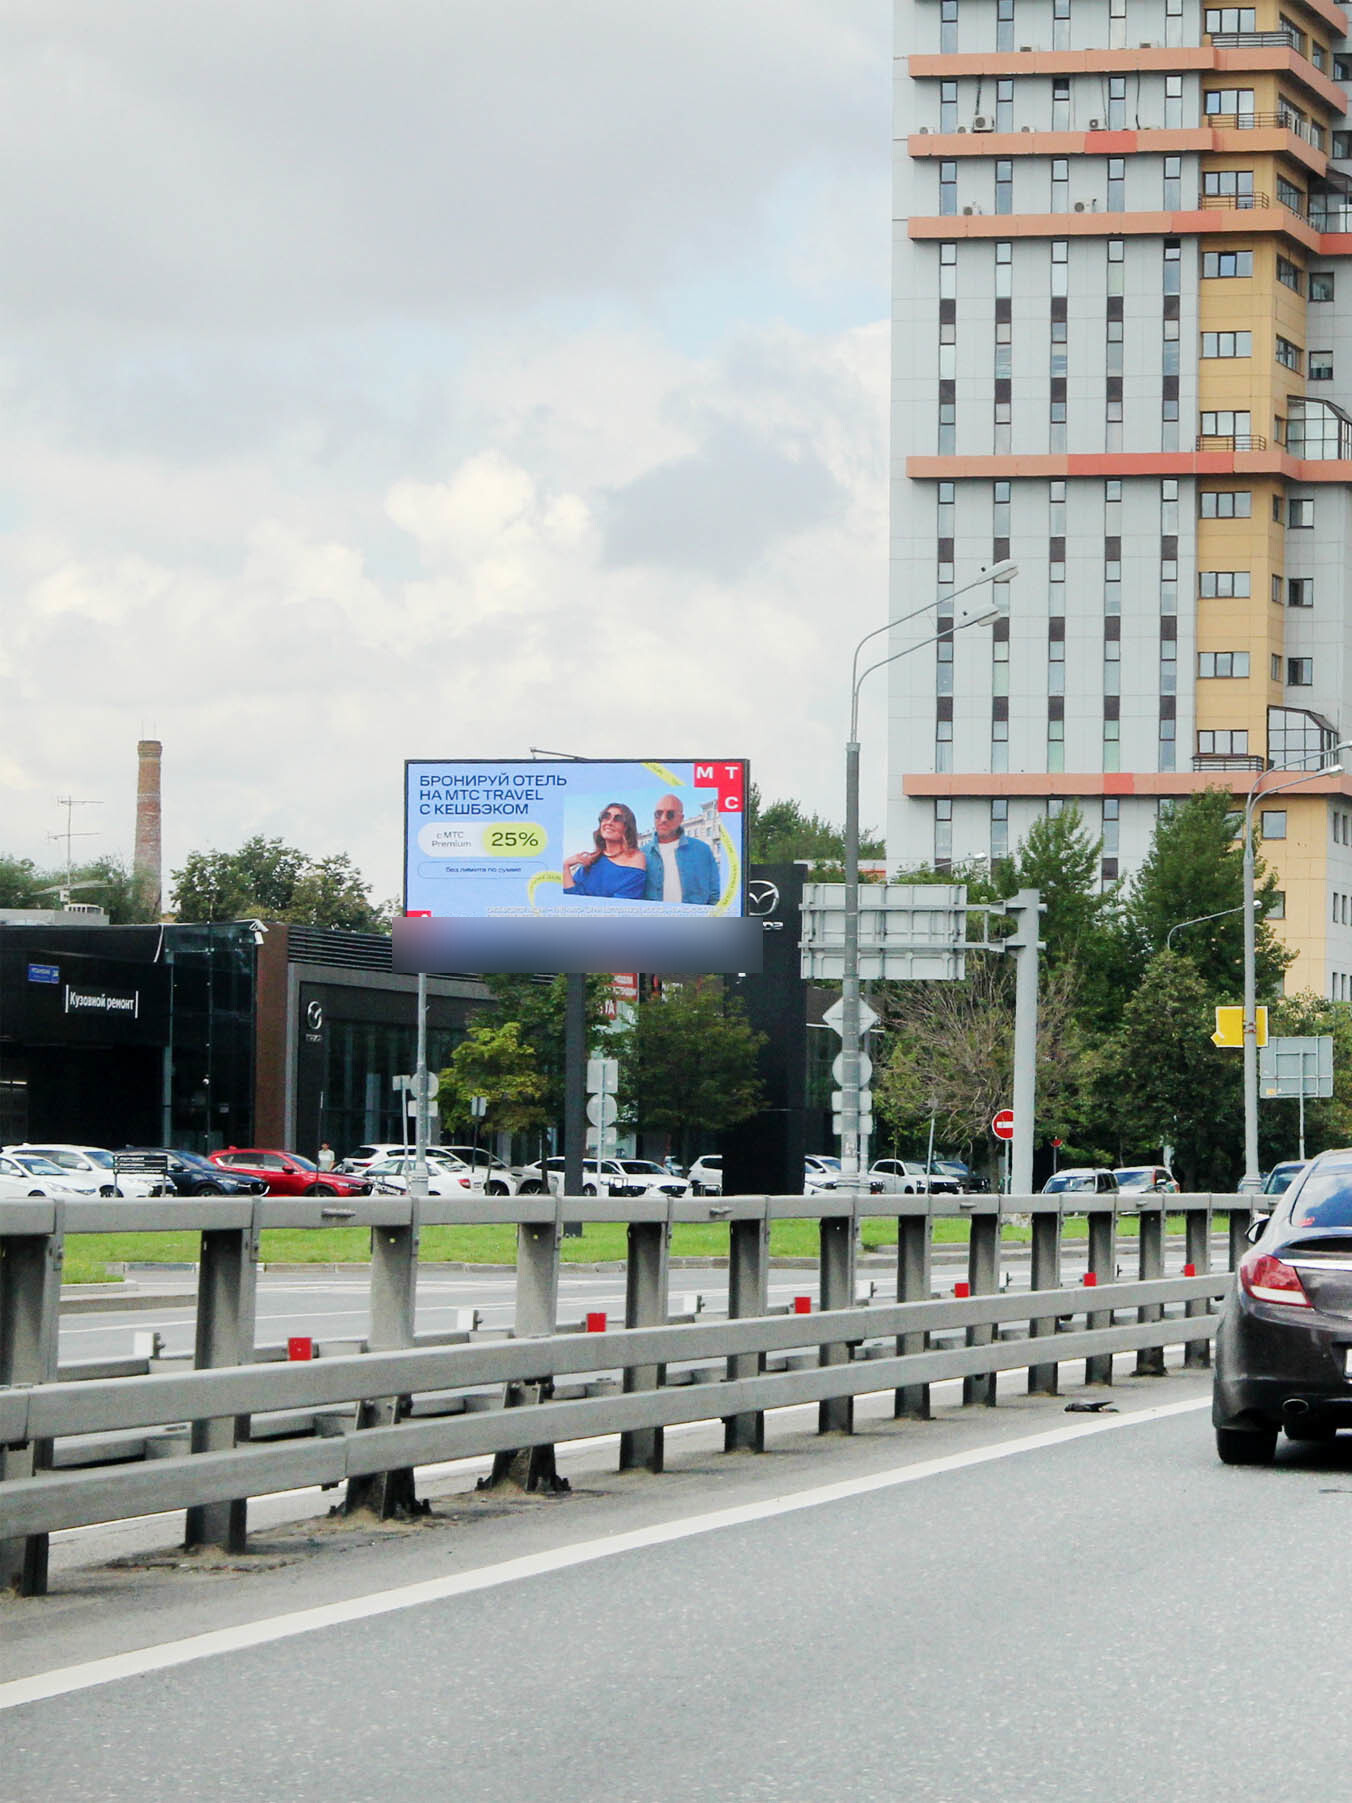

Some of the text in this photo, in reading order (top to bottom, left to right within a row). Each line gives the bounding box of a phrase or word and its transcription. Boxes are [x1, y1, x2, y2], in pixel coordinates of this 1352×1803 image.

[420, 773, 567, 786] БРОНИРУЙ ОТЕЛЬ
[420, 790, 544, 801] НА МТС TRAVEL
[420, 804, 529, 815] С КЕШБЭКОМ
[444, 831, 464, 839] МТС
[491, 832, 539, 847] 25%
[432, 840, 471, 848] Premium
[70, 991, 134, 1011] Кузовной ремонт
